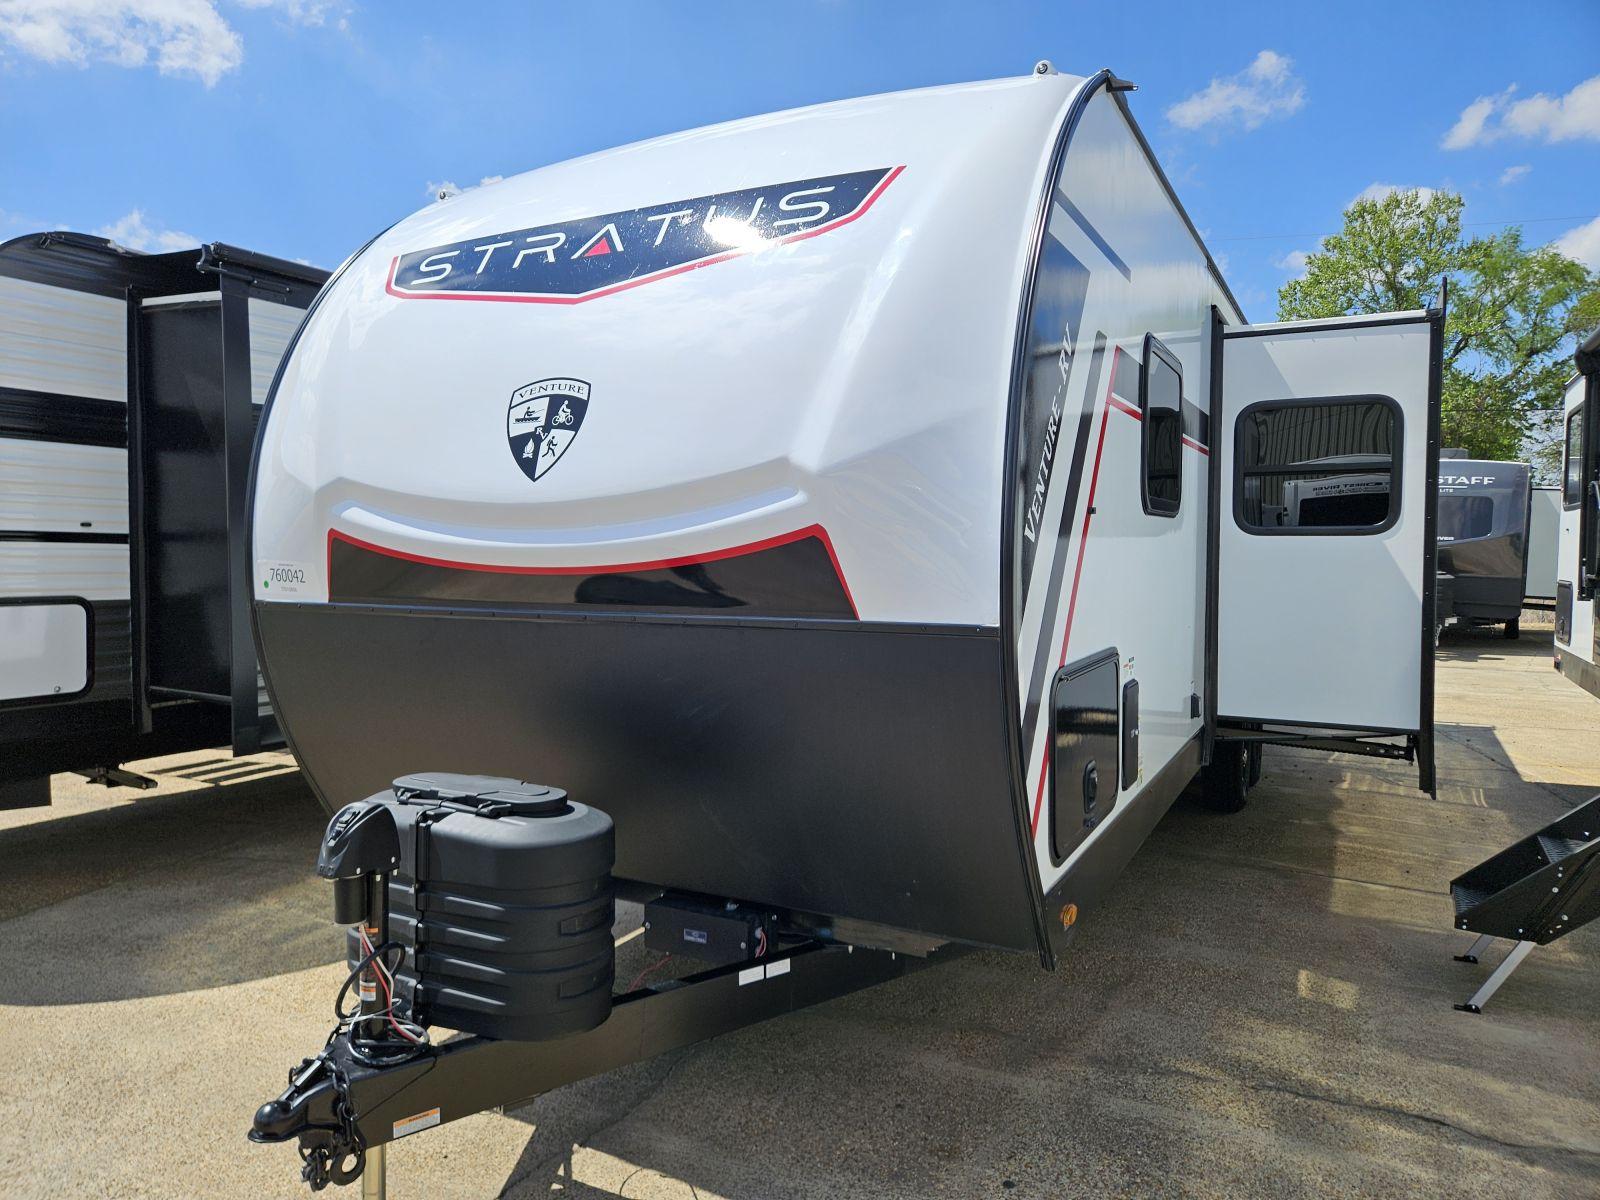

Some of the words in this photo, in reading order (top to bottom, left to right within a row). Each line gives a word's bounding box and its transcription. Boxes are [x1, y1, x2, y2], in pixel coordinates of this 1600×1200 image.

[410, 186, 835, 284] STRATUS
[519, 383, 584, 398] VENTURE
[1024, 396, 1060, 544] VENTURE
[270, 568, 306, 583] 760042
